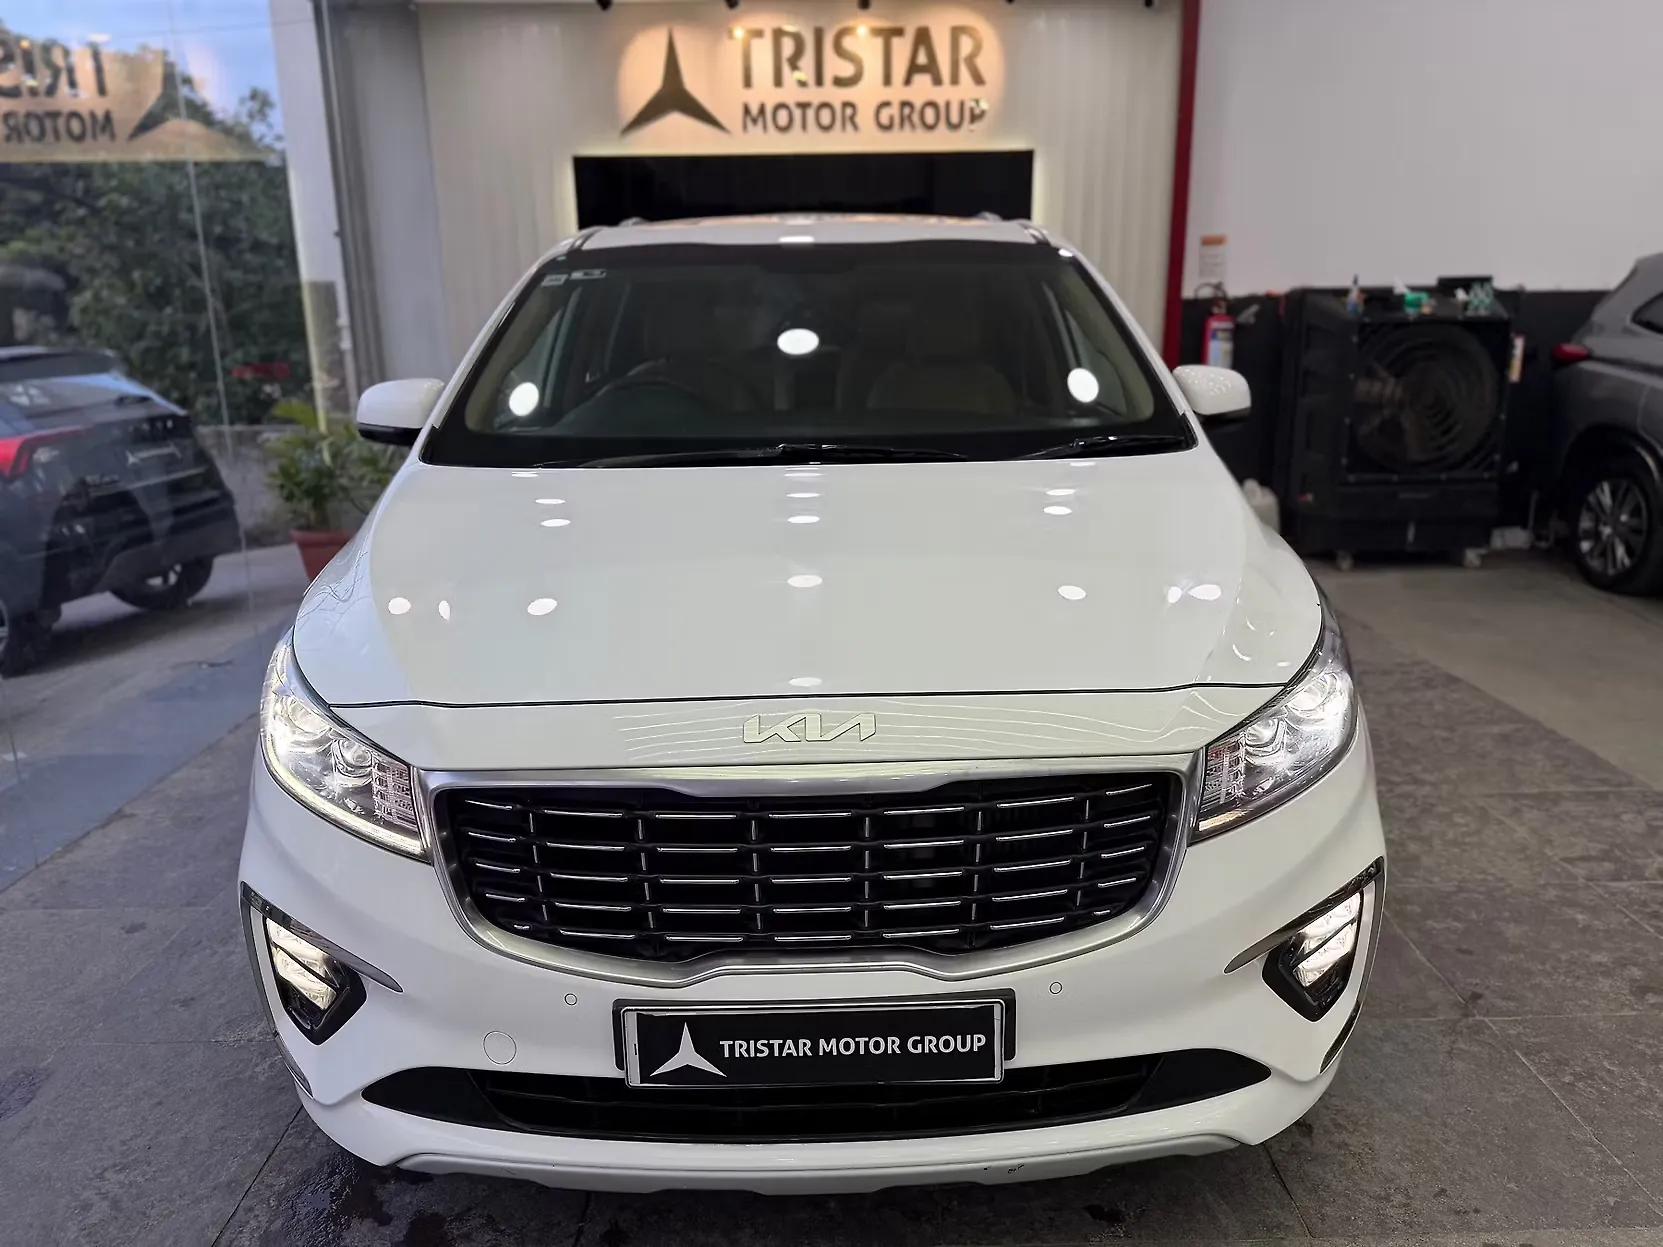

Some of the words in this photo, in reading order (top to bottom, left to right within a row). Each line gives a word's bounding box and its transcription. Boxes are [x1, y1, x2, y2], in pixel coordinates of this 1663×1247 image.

[728, 25, 986, 88] TRISTAR
[742, 101, 858, 133] MOTOR
[875, 99, 988, 132] GROUP
[719, 1039, 813, 1058] TRISTAR
[819, 1036, 902, 1056] MOTOR
[907, 1033, 987, 1054] GROUP
